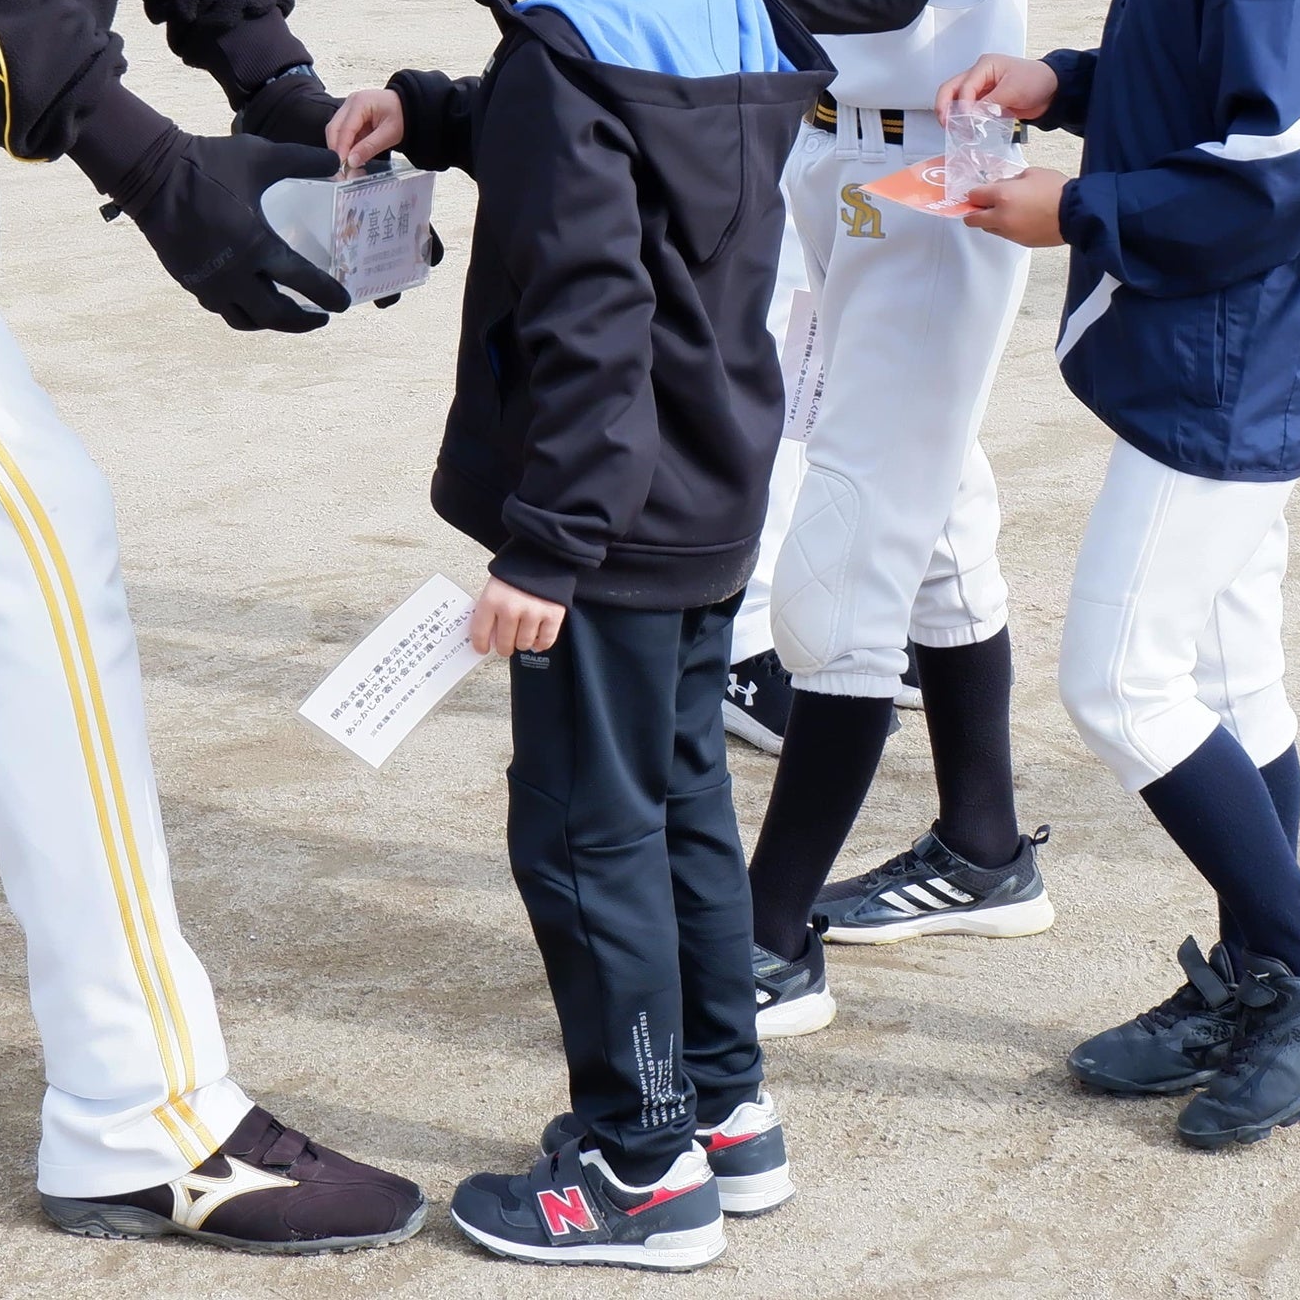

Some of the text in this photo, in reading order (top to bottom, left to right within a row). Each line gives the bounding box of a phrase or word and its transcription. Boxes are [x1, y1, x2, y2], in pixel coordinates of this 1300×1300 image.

[366, 200, 411, 246] 募金箱
[369, 636, 472, 738] ※保護者の皆様もご参加いただけま
[647, 1059, 656, 1077] LES
[537, 1185, 599, 1236] N
